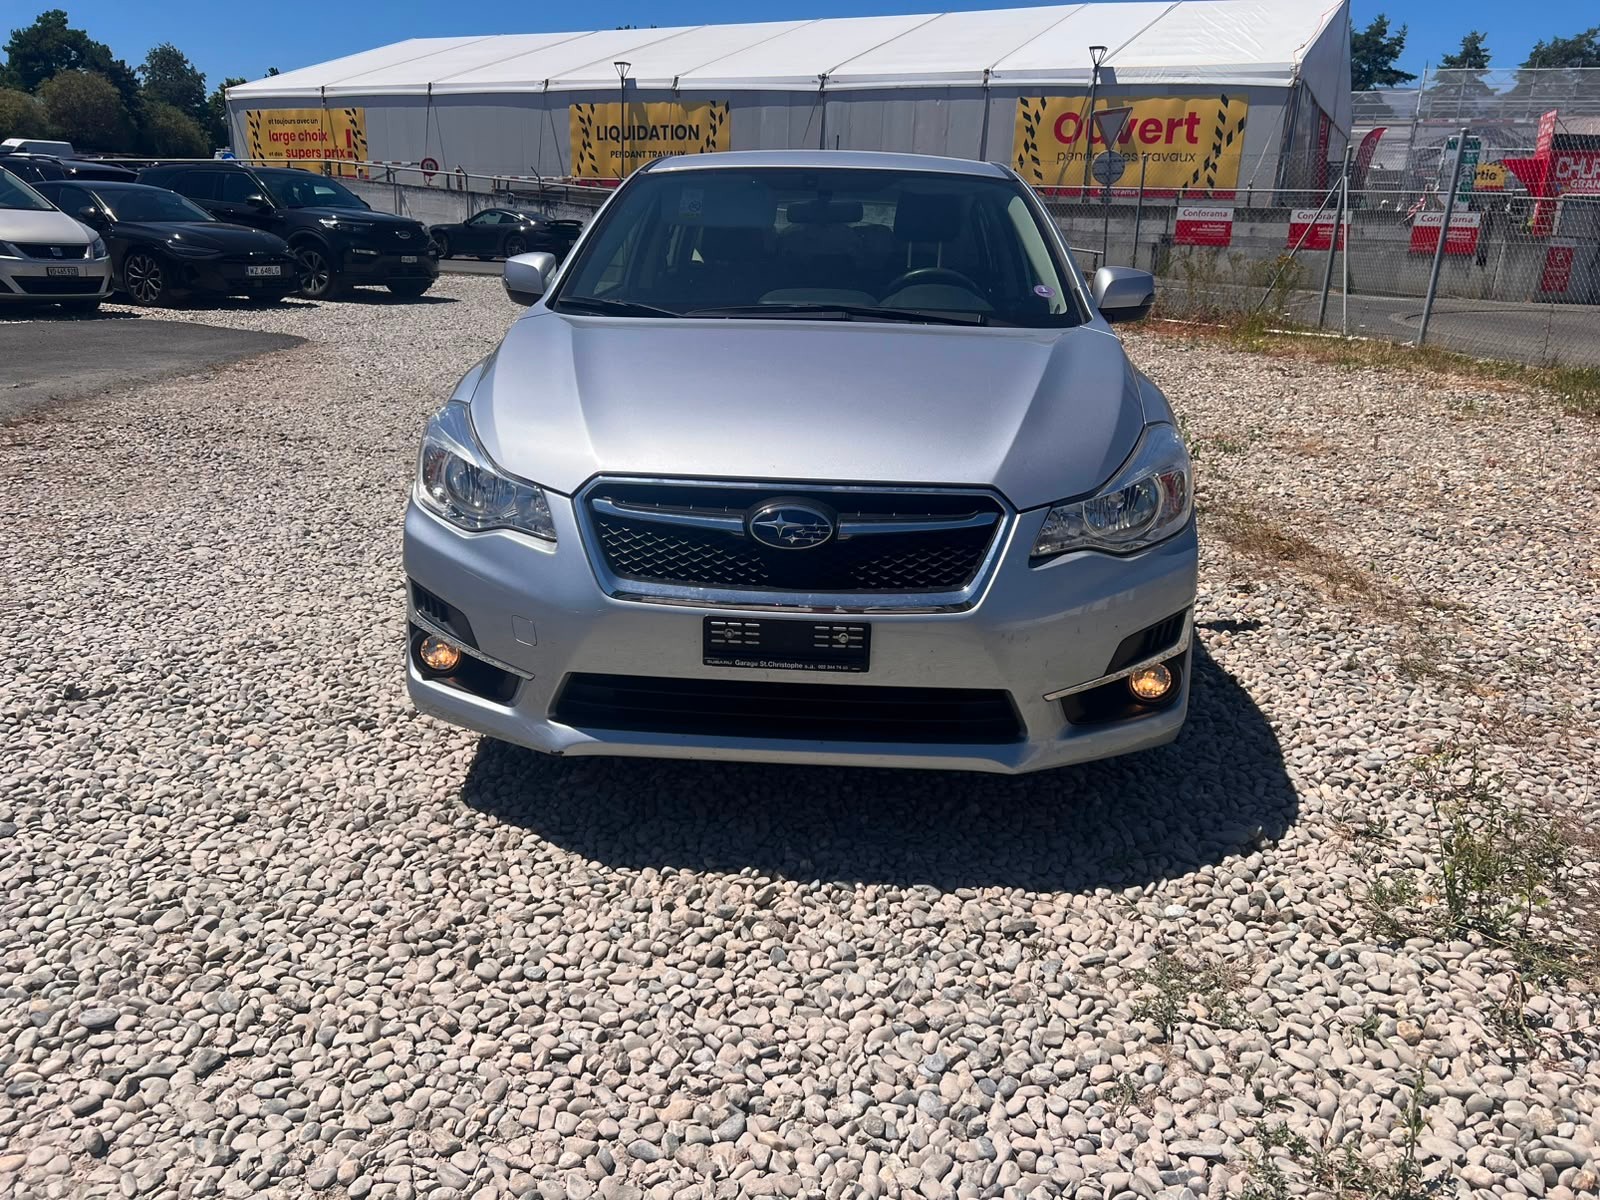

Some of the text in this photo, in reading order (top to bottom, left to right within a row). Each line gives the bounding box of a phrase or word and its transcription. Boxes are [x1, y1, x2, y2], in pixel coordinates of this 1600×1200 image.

[275, 118, 296, 126] toujours
[268, 129, 328, 145] large choix
[596, 125, 700, 143] LIQUIDATION
[285, 148, 321, 160] supers
[324, 148, 346, 160] prix
[1142, 150, 1196, 162] travaux
[1183, 209, 1228, 218] Conforama
[1297, 211, 1345, 220] Conoraa
[1421, 214, 1474, 223] Confama
[735, 659, 758, 667] Garage
